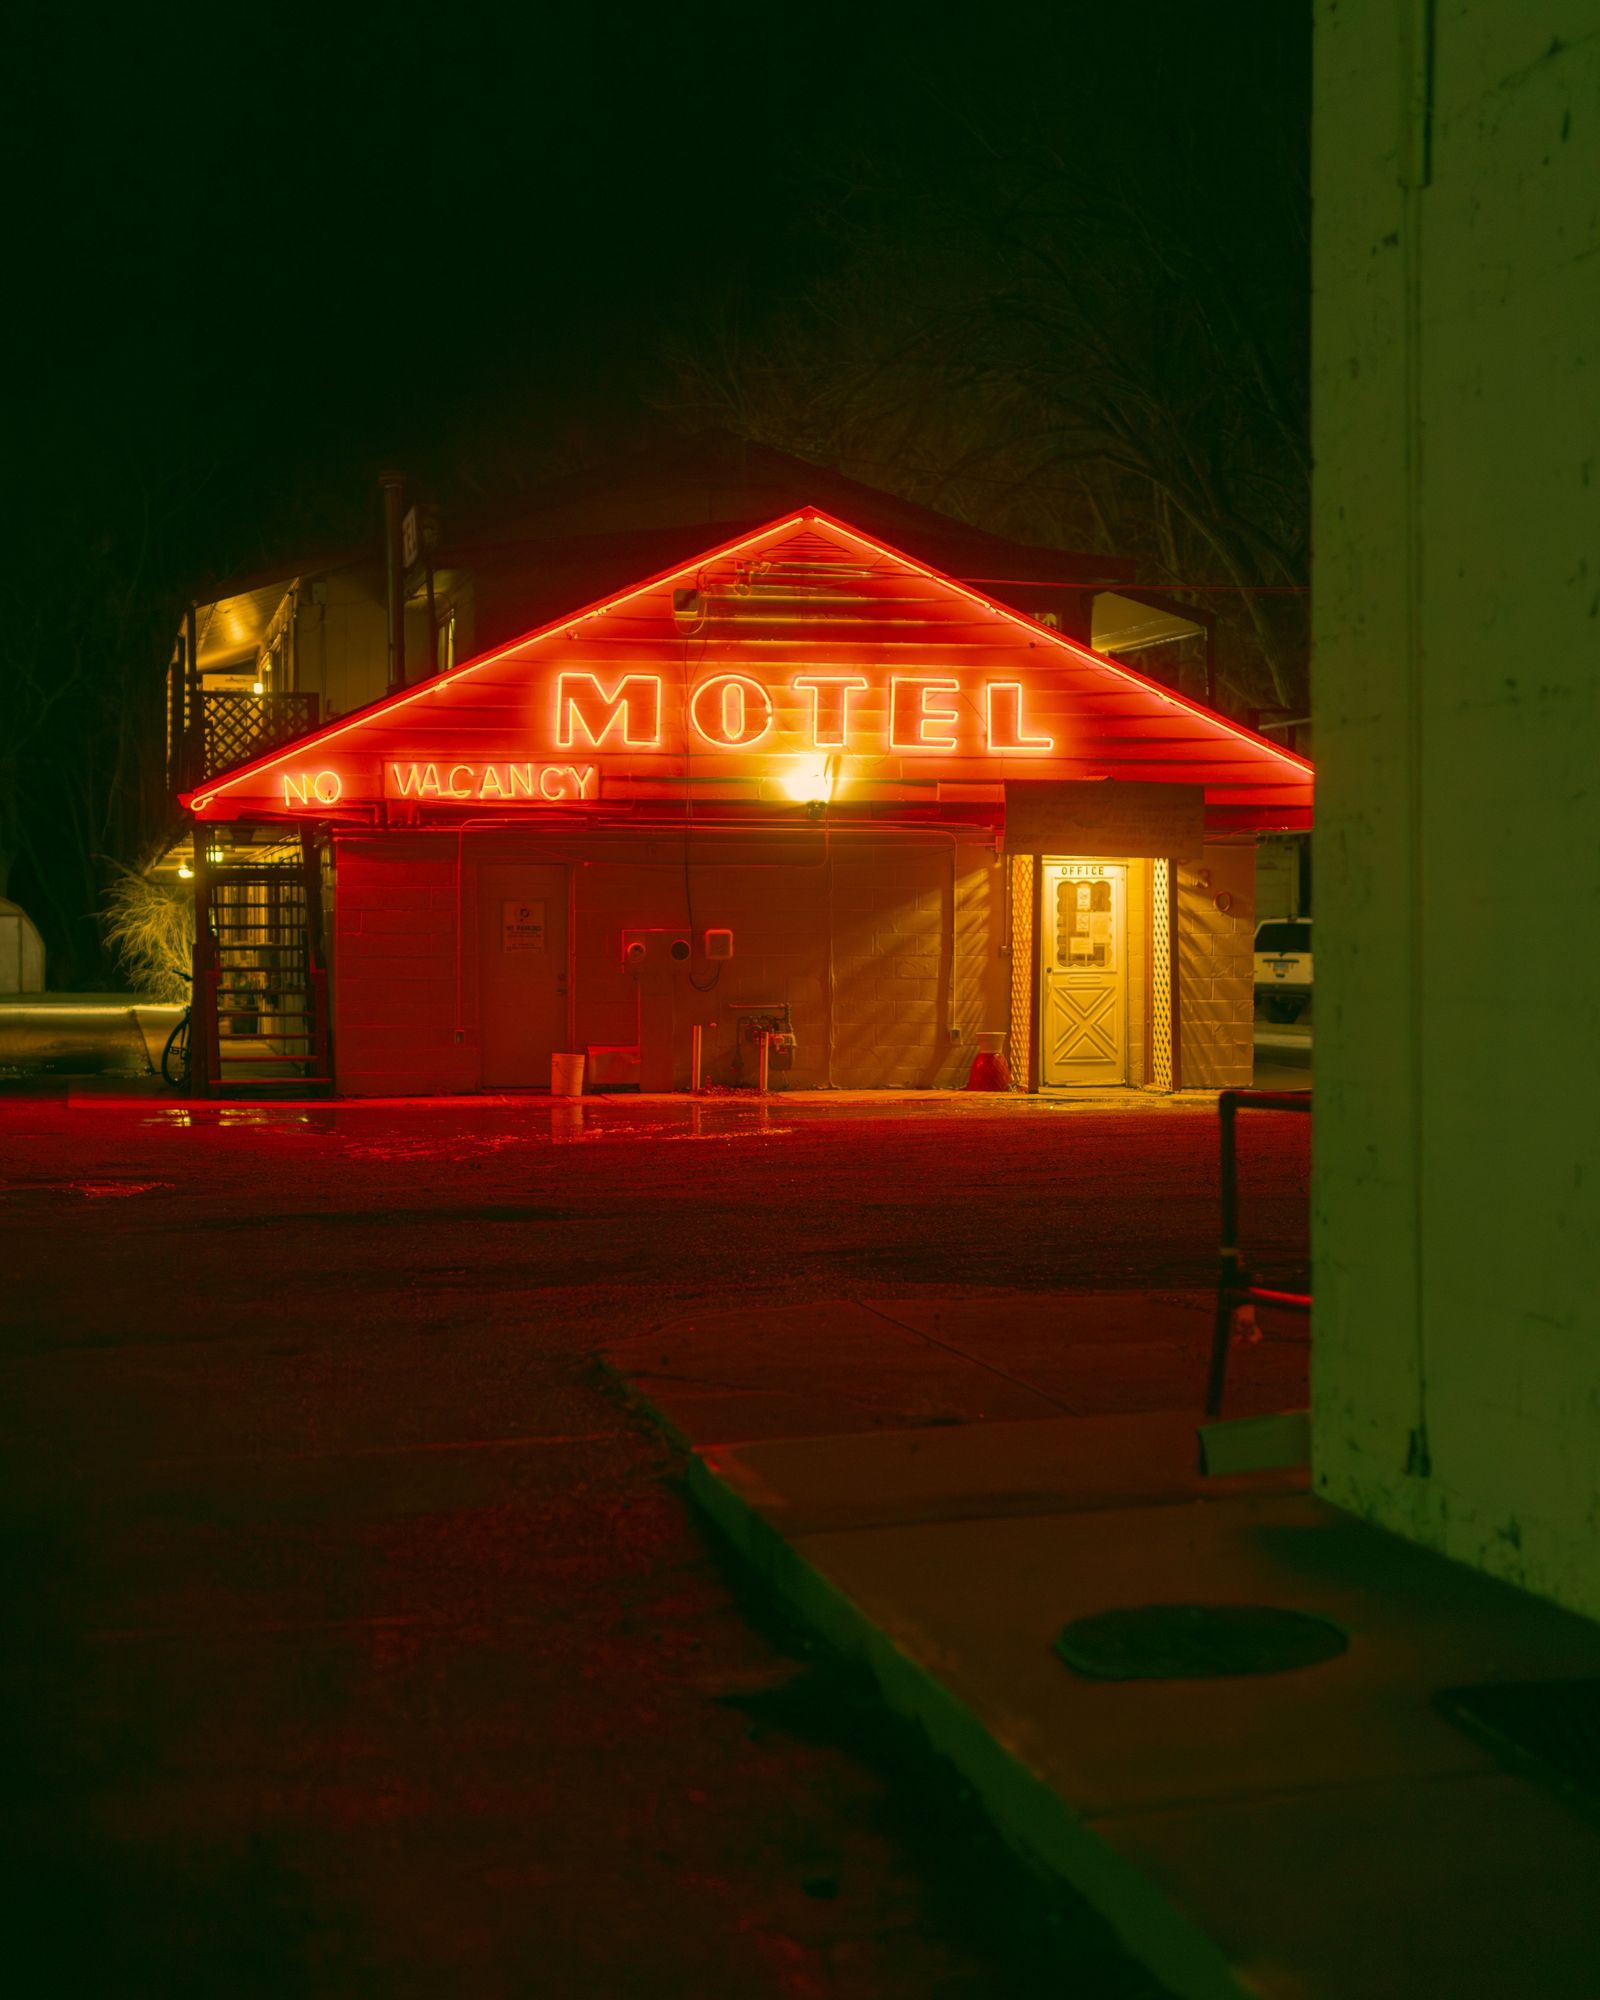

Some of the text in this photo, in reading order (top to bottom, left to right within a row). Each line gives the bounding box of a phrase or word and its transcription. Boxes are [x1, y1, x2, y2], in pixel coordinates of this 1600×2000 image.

[556, 672, 1054, 750] MOTEL
[282, 762, 595, 807] NO VACANCY
[1061, 866, 1104, 876] OFFICE
